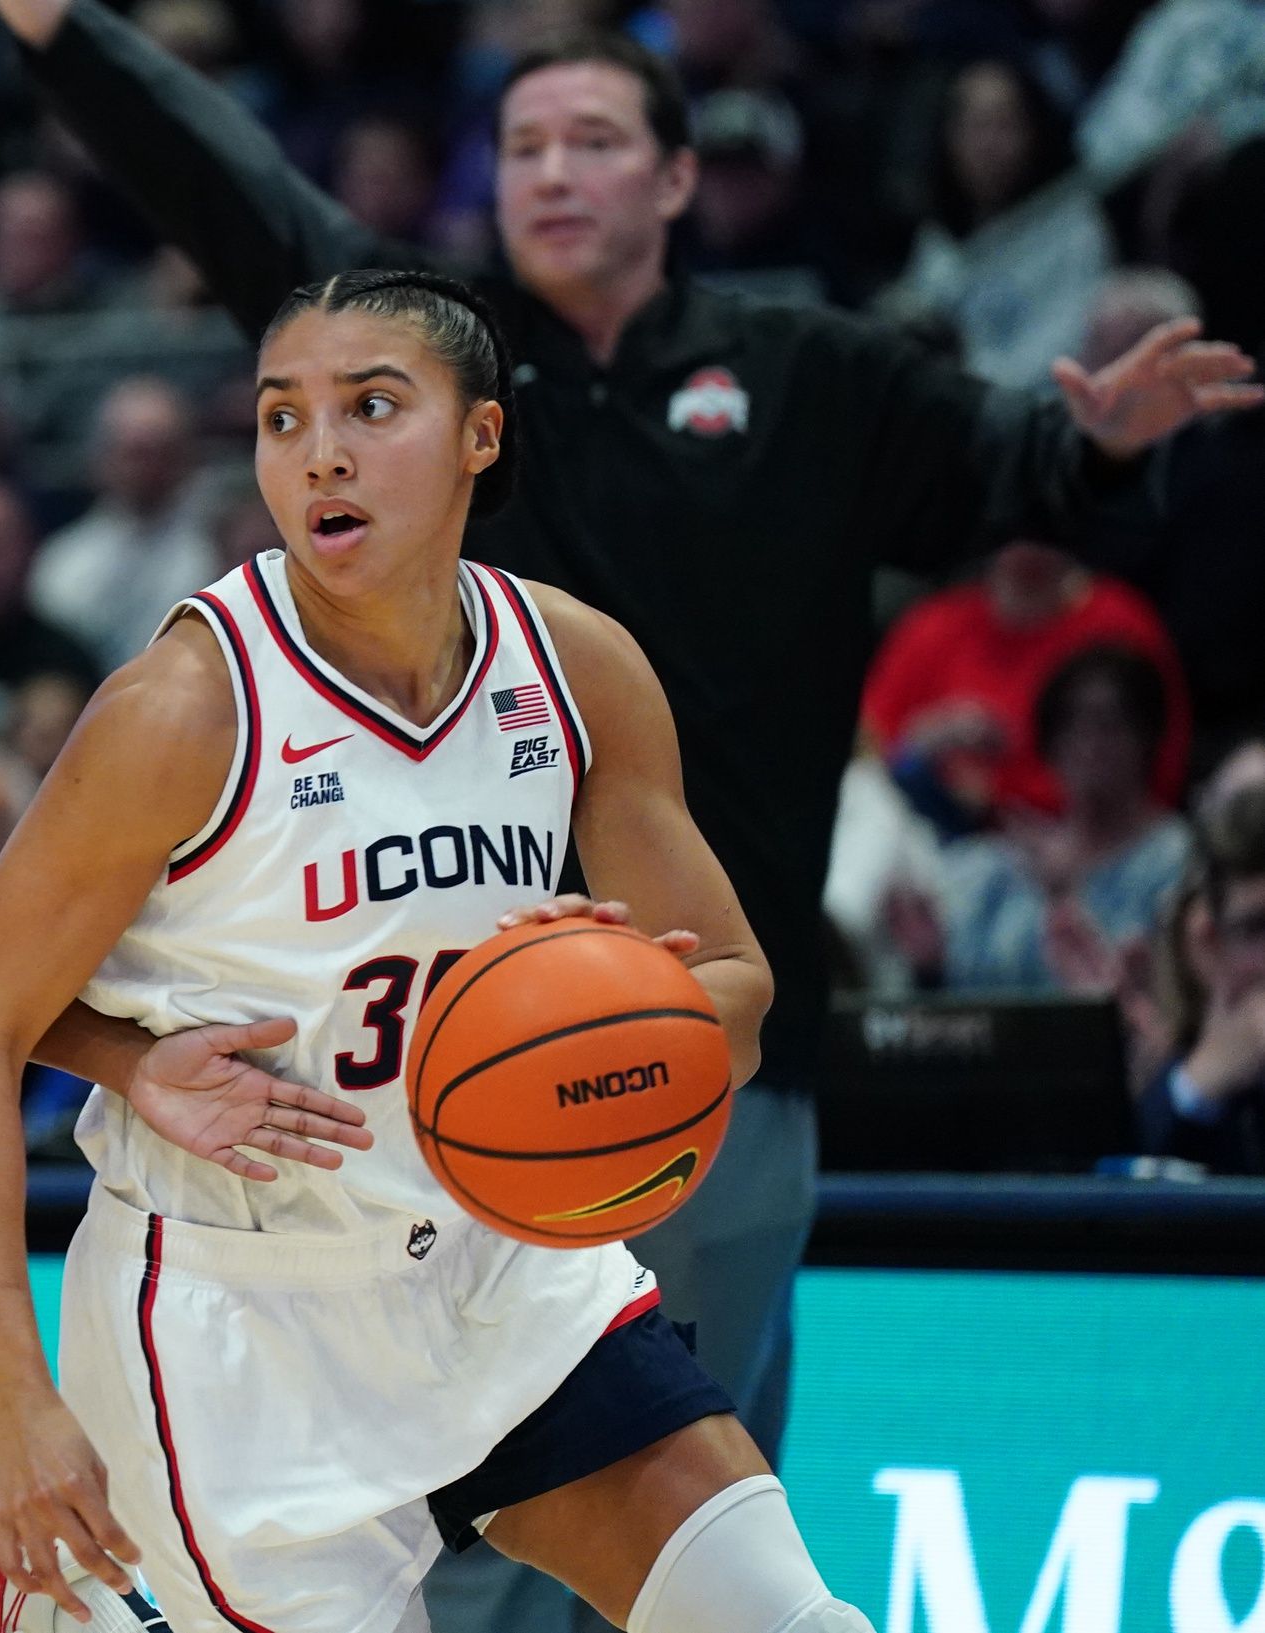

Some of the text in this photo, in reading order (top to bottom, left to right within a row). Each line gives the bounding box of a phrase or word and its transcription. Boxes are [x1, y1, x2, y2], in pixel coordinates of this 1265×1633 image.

[510, 748, 560, 770] EAST
[513, 736, 548, 756] BIG
[294, 776, 313, 793] BE
[303, 824, 553, 922] UCONN
[334, 949, 471, 1091] 3
[556, 1062, 669, 1109] UCONN
